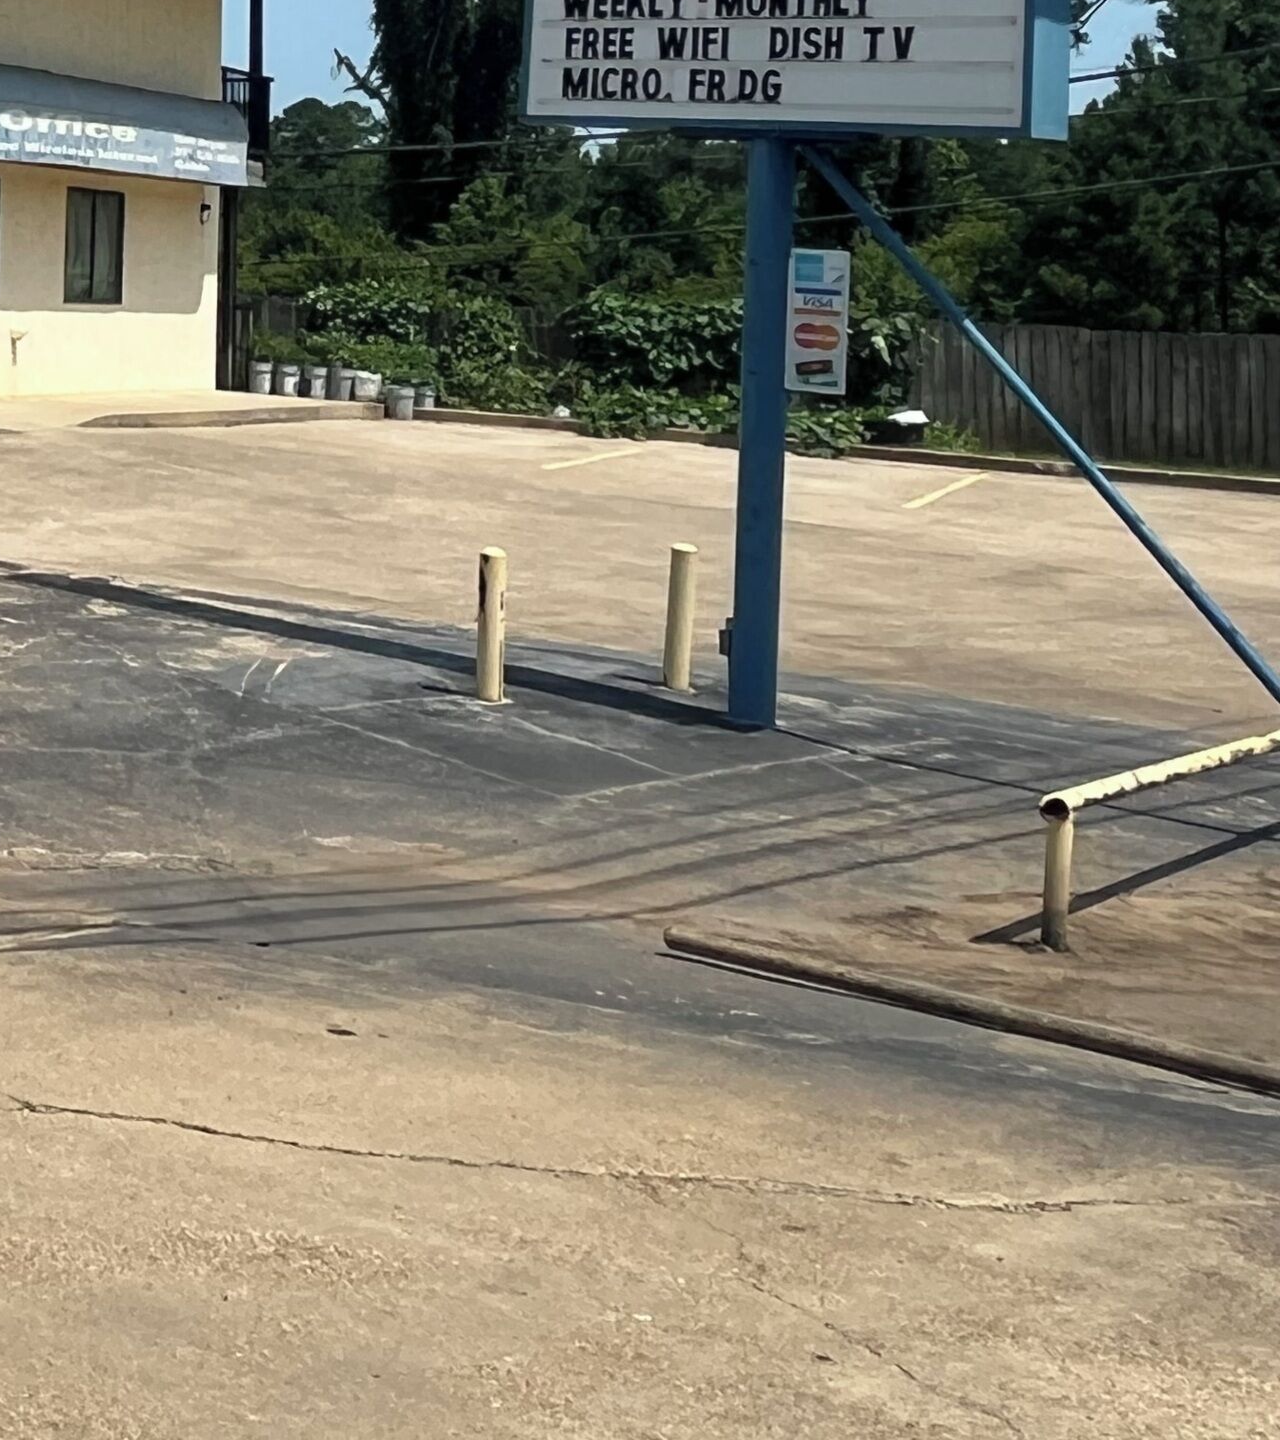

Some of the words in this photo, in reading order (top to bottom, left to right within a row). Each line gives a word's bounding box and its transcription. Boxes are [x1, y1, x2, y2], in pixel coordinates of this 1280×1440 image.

[565, 28, 635, 60] FREE
[658, 27, 729, 60] WIFI
[768, 27, 844, 60] DISH
[863, 26, 915, 61] TV
[803, 296, 833, 309] VISA
